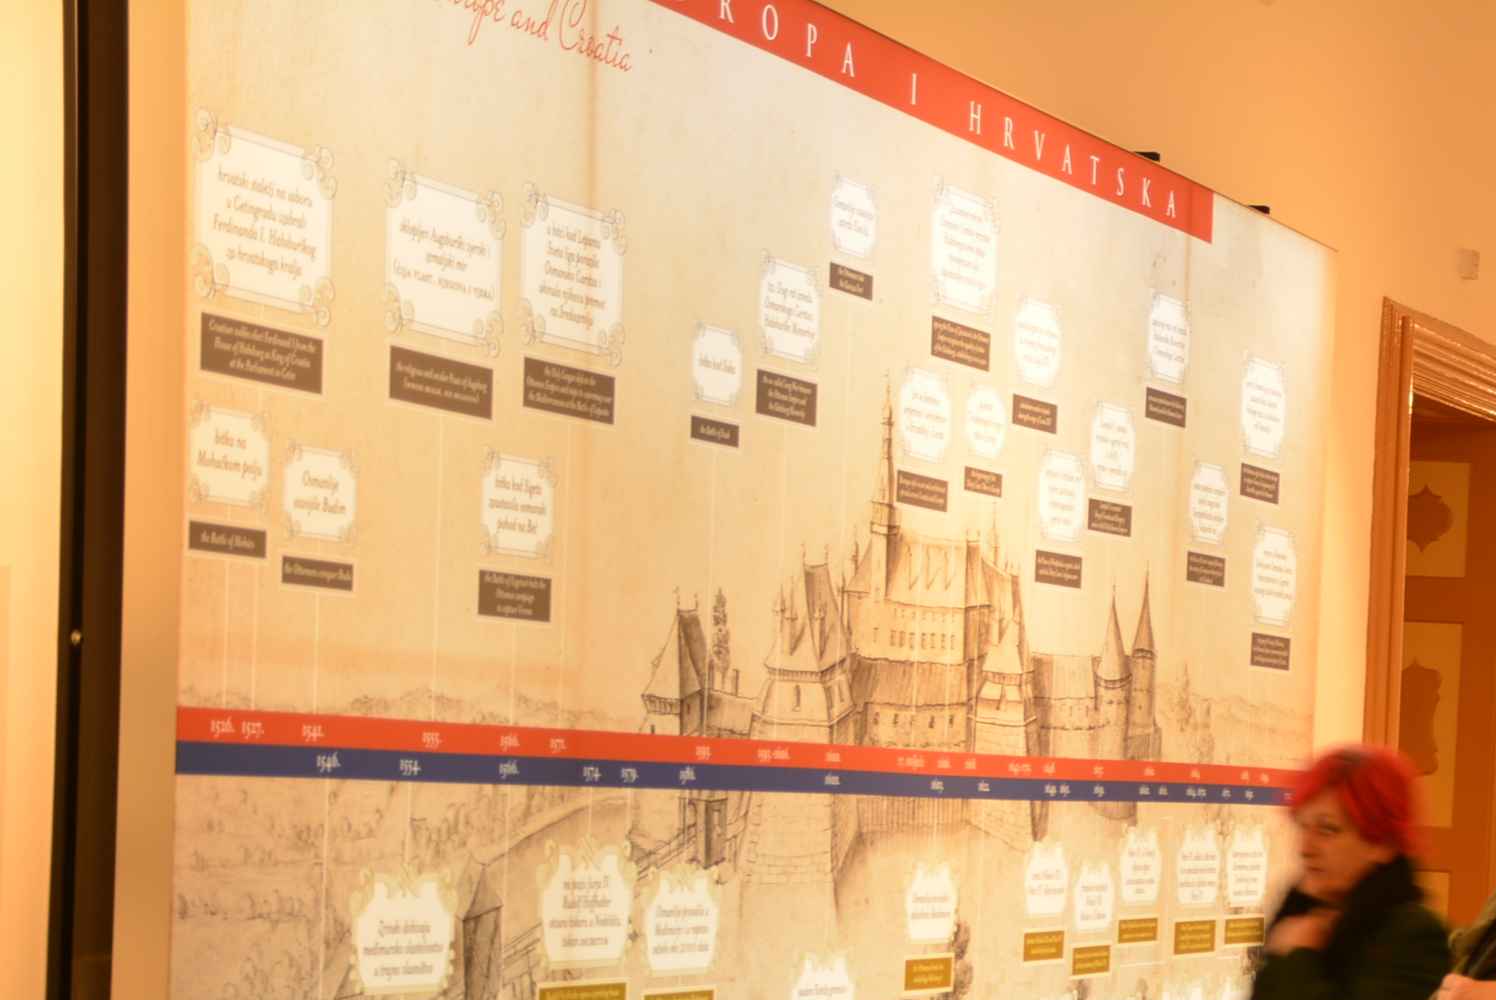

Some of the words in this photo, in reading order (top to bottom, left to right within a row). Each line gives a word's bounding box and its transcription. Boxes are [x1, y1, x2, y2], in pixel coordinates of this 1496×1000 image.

[559, 0, 633, 72] Croatia
[910, 73, 918, 106] I
[969, 100, 1176, 219] HRVATSKA
